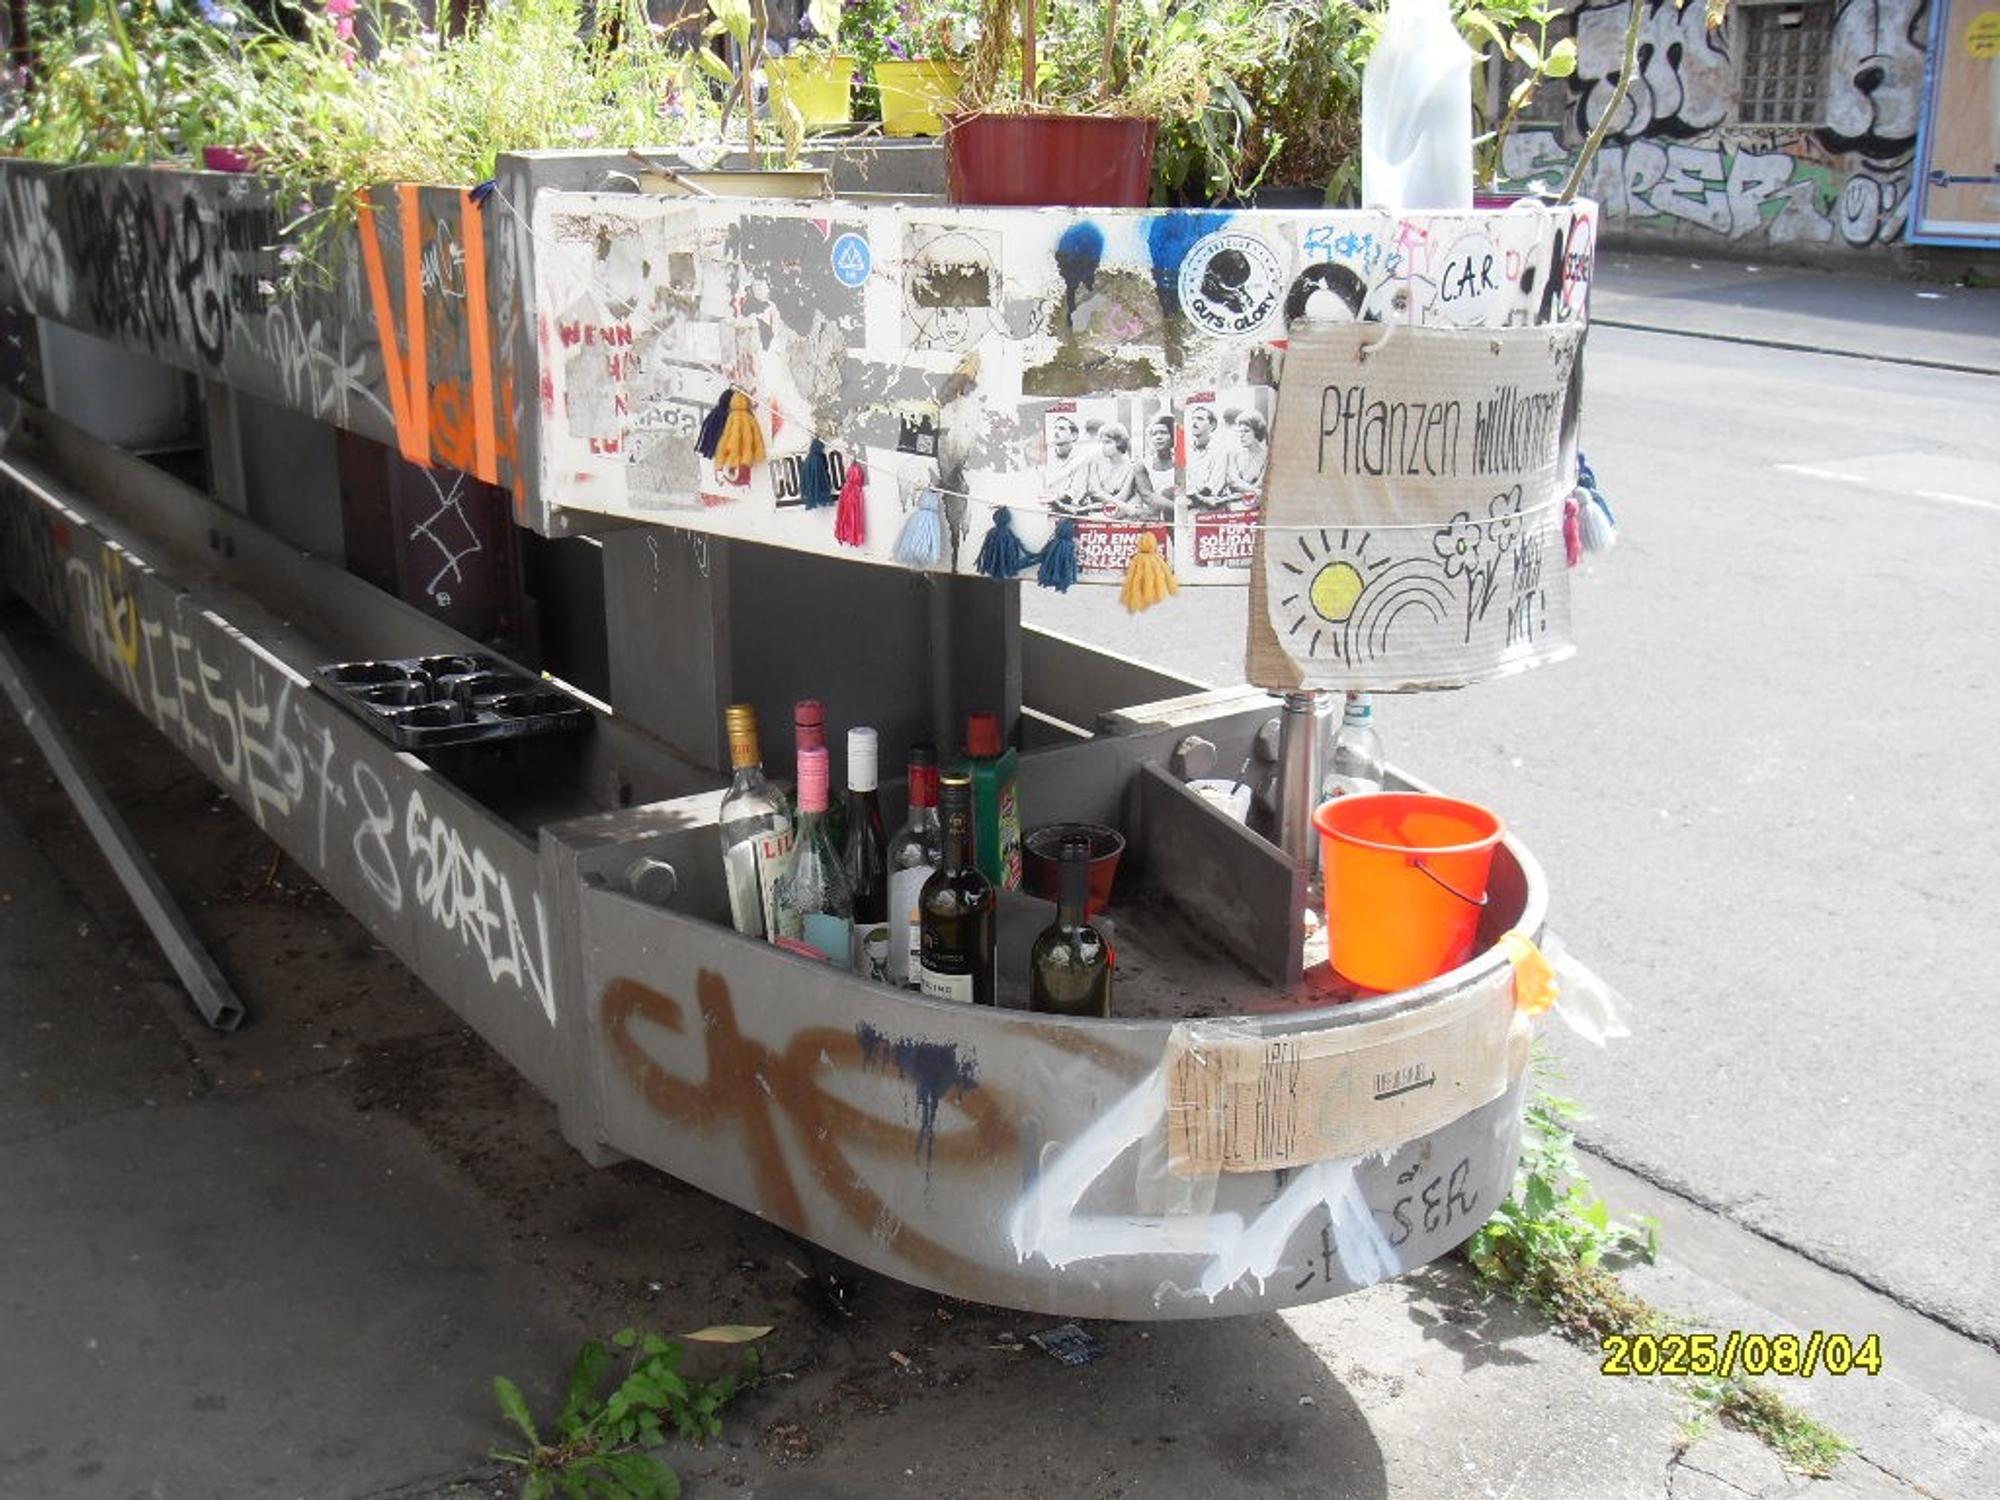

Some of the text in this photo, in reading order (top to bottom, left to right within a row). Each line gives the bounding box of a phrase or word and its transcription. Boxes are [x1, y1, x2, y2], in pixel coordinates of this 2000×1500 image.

[1441, 253, 1499, 302] C.A.R.
[1193, 299, 1226, 328] GUTS
[1234, 291, 1275, 330] GLORY
[1318, 384, 1460, 478] Pflanzen
[1199, 544, 1255, 560] GESELLS
[763, 834, 797, 859] LIL
